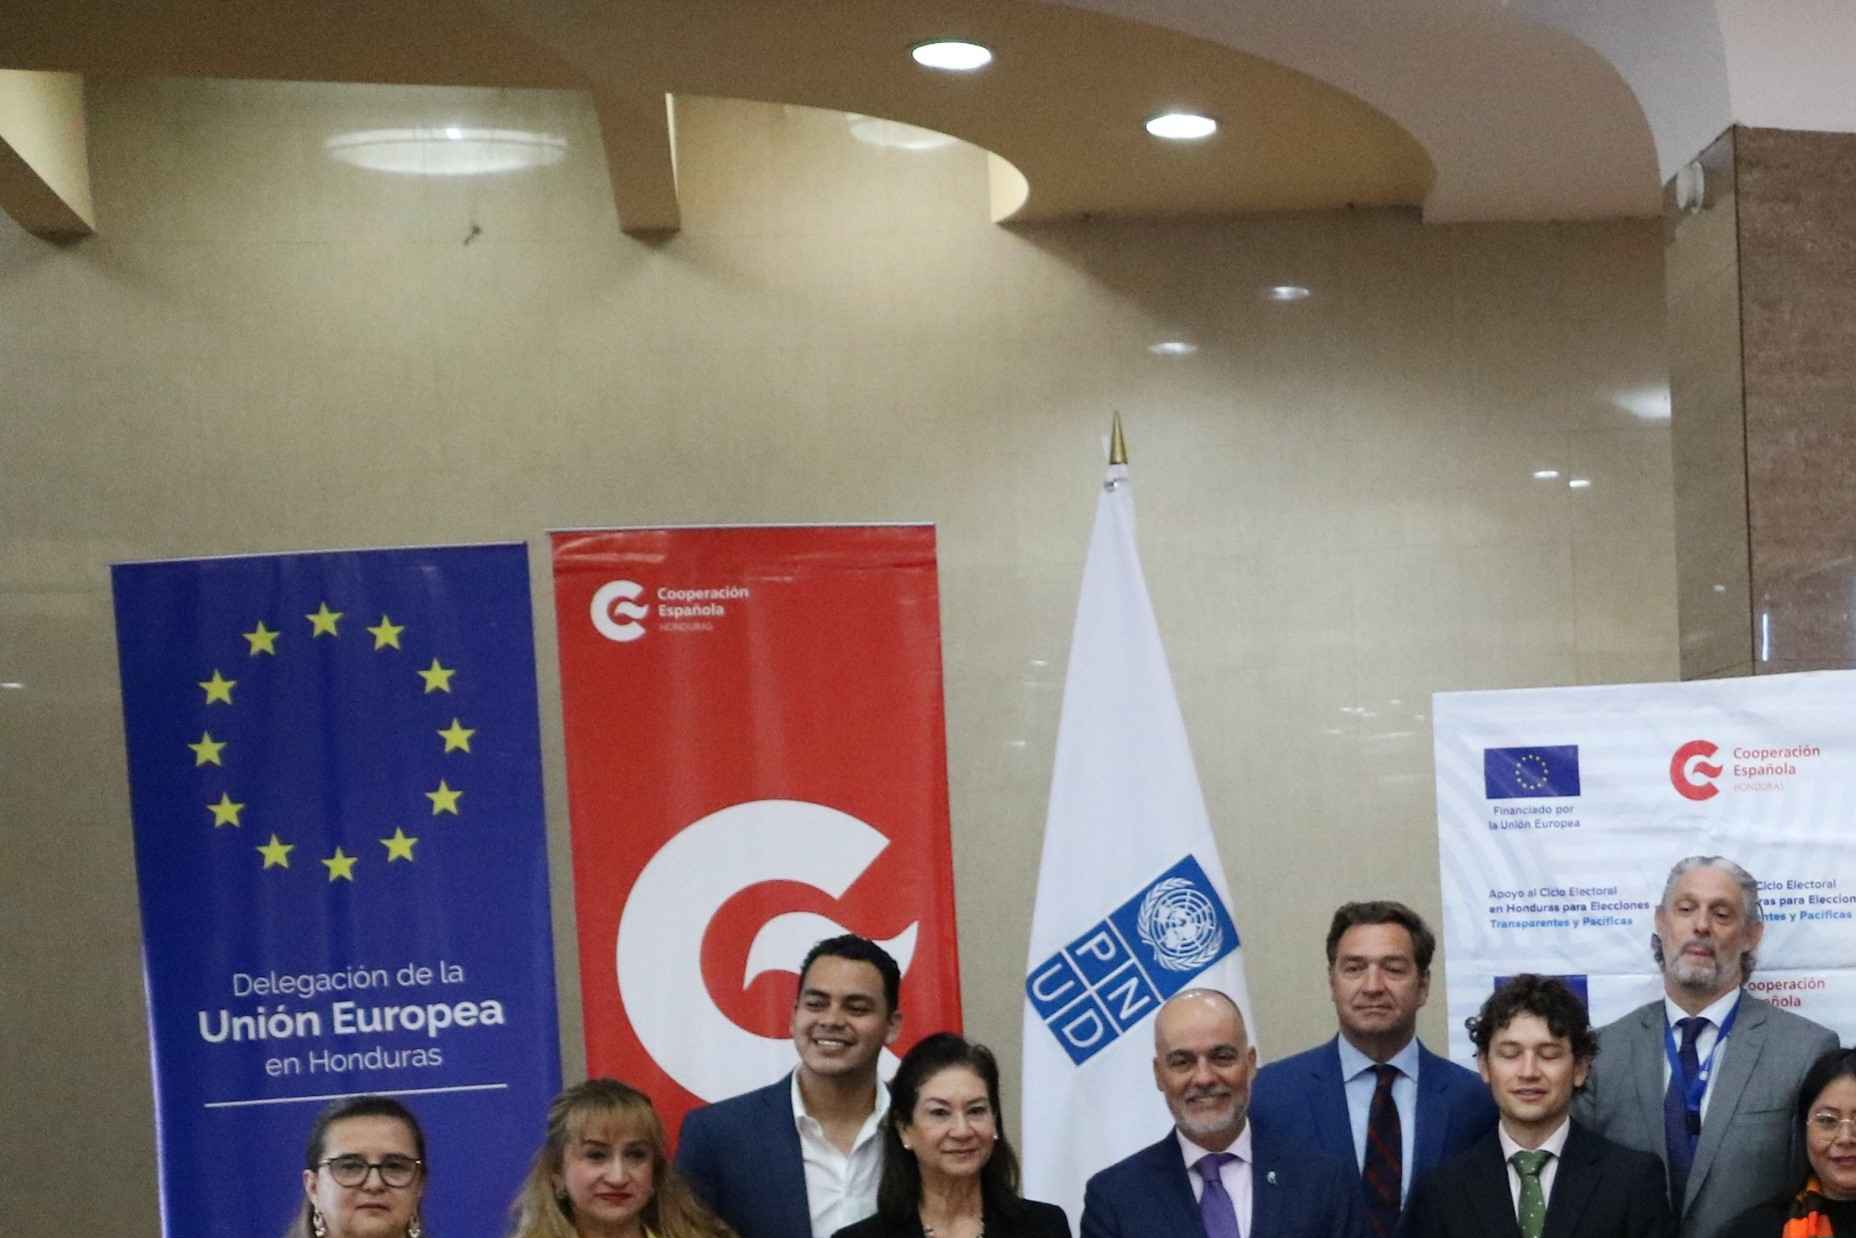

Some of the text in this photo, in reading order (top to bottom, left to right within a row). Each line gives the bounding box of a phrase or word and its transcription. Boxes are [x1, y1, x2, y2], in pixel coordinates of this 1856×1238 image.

[656, 586, 750, 602] Cooperación
[657, 603, 725, 619] Española
[1733, 745, 1820, 760] Cooperación
[1733, 762, 1797, 778] Española
[1493, 804, 1574, 816] Financiado por
[1488, 818, 1581, 831] la Unión Europea
[1786, 879, 1837, 890] Electoral
[1489, 885, 1618, 901] Apoyo al Ciclo Electoral
[1489, 900, 1650, 915] en Honduras para Elecciones
[1779, 897, 1805, 908] para
[1789, 911, 1797, 922] y
[1490, 918, 1570, 931] Transparentes
[1572, 918, 1580, 930] y
[232, 960, 465, 999] Delegación de la
[1748, 976, 1825, 992] ooperación
[198, 997, 506, 1044] Unión Europea
[265, 1045, 444, 1077] en Honduras
